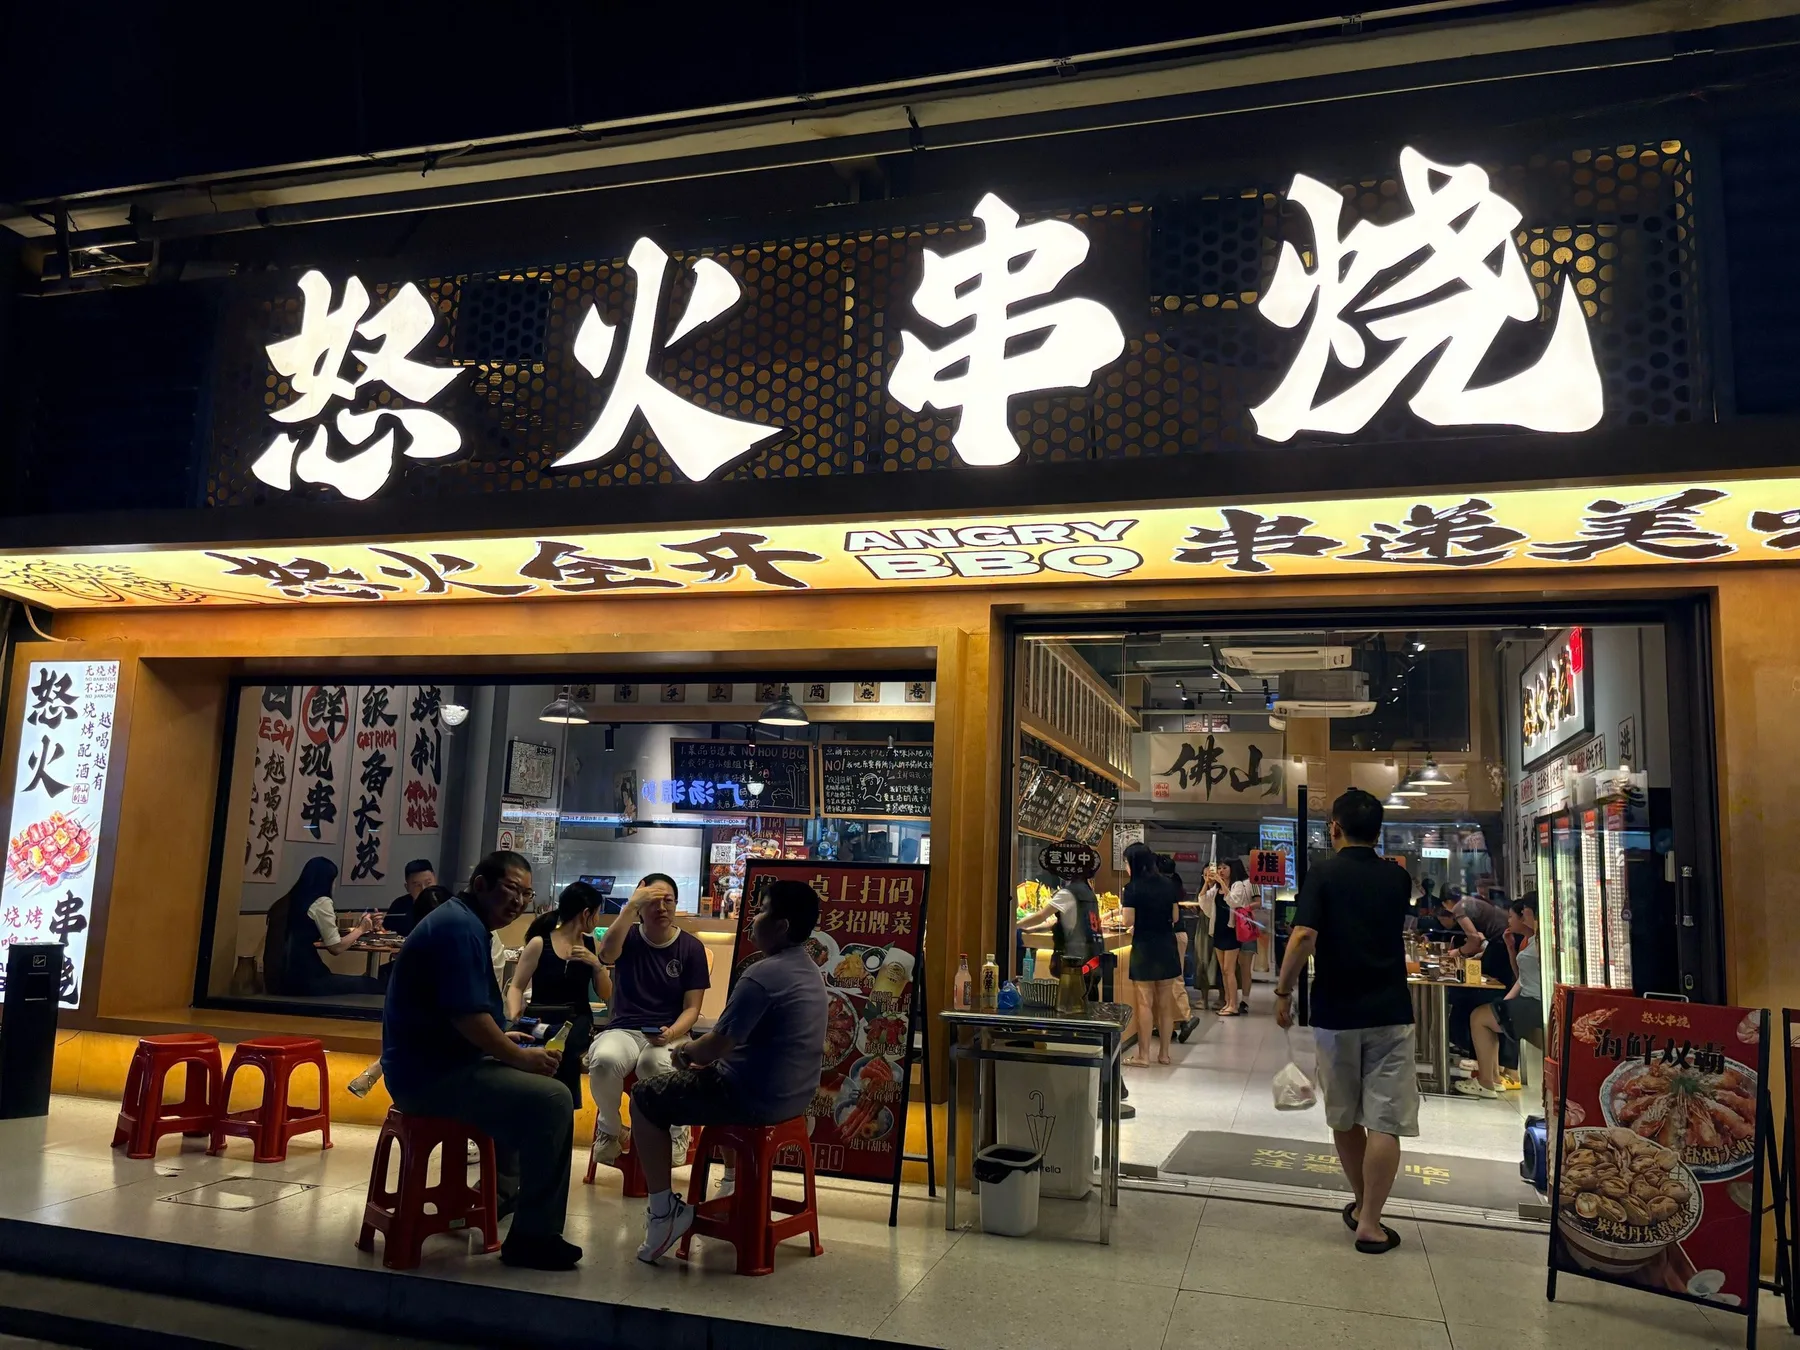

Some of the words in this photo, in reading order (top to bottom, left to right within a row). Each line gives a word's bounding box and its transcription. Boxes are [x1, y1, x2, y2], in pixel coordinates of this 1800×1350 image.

[252, 146, 1604, 501] 怒火串烧
[845, 519, 1140, 552] ANGRY
[205, 532, 826, 599] 怒火全开
[856, 547, 1144, 581] BBQ
[85, 682, 115, 693] 不江湖
[21, 667, 78, 797] 怒火
[76, 702, 97, 779] 烧烤配酒
[91, 712, 111, 791] 越喝越有
[782, 748, 804, 759] BBQ
[1152, 735, 1283, 801] 佛山
[253, 752, 287, 878] 越喝越有
[1049, 851, 1091, 866] 营业中
[1257, 852, 1279, 872] 推
[3, 906, 43, 930] 烧烤
[1641, 1011, 1691, 1028] 怒火串烧
